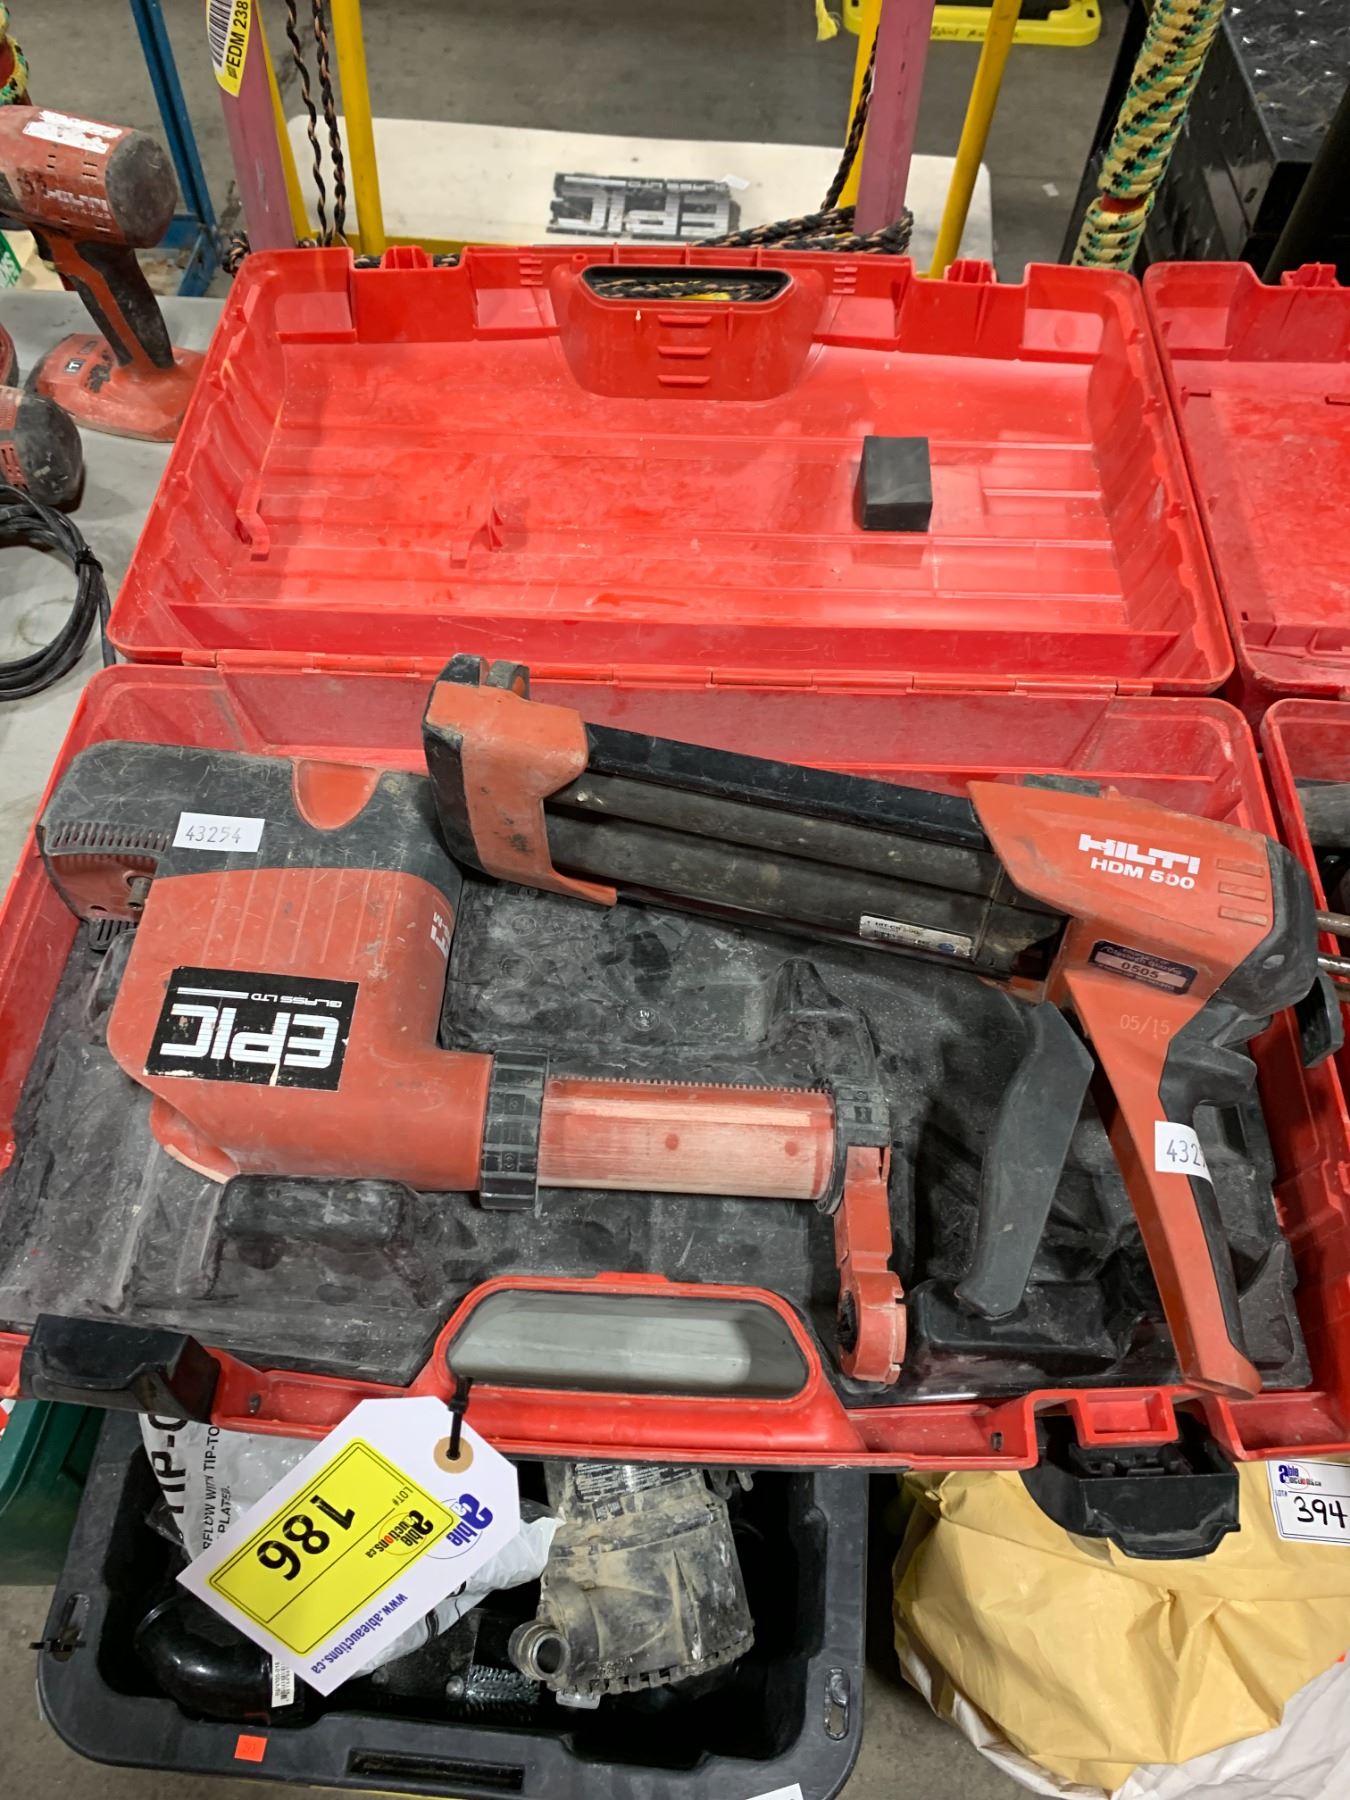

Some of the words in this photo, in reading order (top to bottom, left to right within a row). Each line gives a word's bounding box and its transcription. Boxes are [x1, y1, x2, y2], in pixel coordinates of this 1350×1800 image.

[232, 0, 249, 30] 238
[226, 32, 245, 68] EDM
[185, 824, 242, 845] 43254
[1078, 833, 1201, 875] HILTI
[1090, 856, 1145, 879] HDM
[1149, 868, 1196, 889] 500
[1120, 961, 1159, 979] 0505
[250, 992, 278, 1002] LTD
[279, 994, 343, 1008] GLASS
[159, 1002, 340, 1070] EPIC
[1166, 1139, 1205, 1168] 432
[391, 1486, 414, 1506] LOT#
[1293, 1495, 1349, 1529] 394
[400, 1509, 434, 1547] able
[445, 1492, 494, 1547] able
[256, 1494, 356, 1581] 186
[310, 1592, 409, 1675] www.ableauctions.ca
